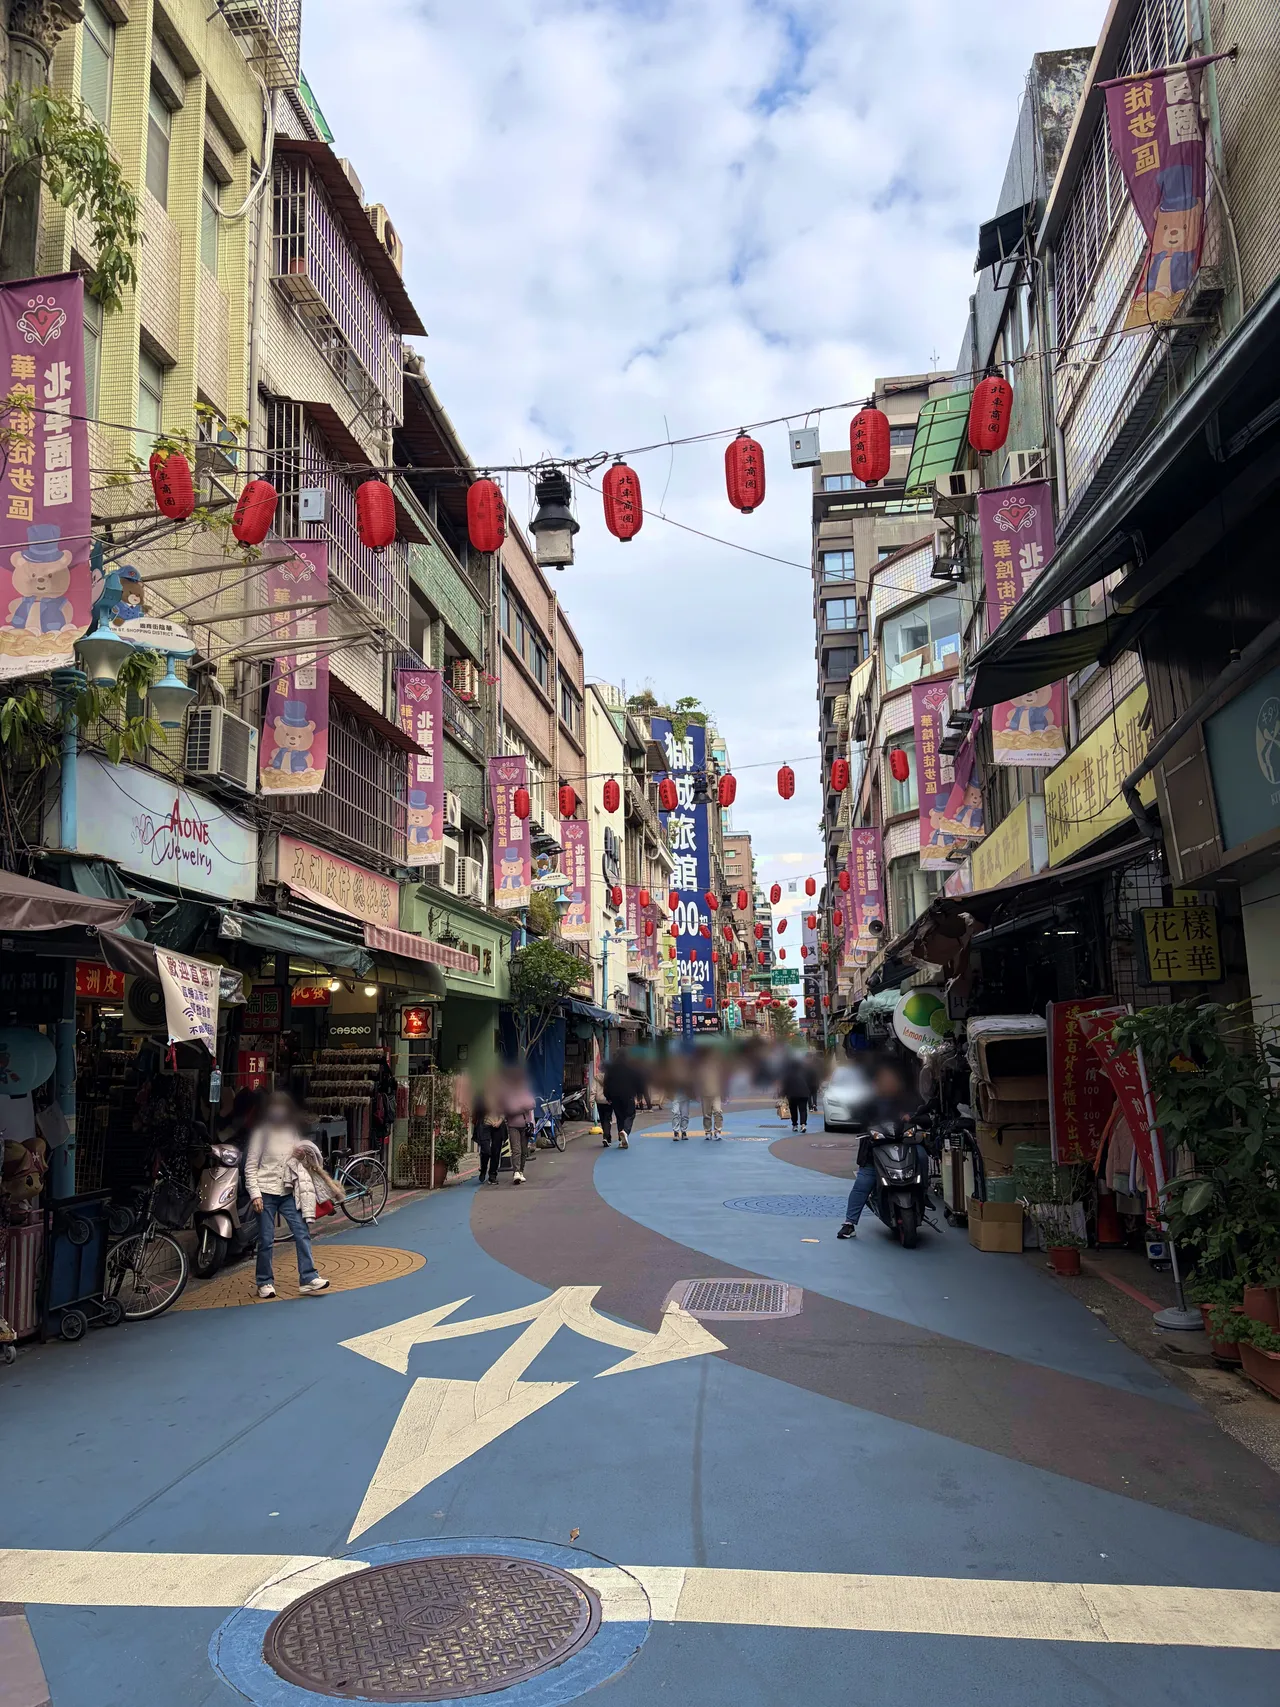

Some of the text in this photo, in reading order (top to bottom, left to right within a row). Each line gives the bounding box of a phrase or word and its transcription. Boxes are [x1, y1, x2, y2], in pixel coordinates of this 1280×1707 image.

[852, 416, 867, 464] 北車商圈
[742, 444, 757, 490] 北車商圈
[619, 475, 634, 523] 北車商圈
[158, 840, 212, 876] Jewelry
[1146, 909, 1213, 942] 花樣
[1152, 945, 1217, 979] 年華
